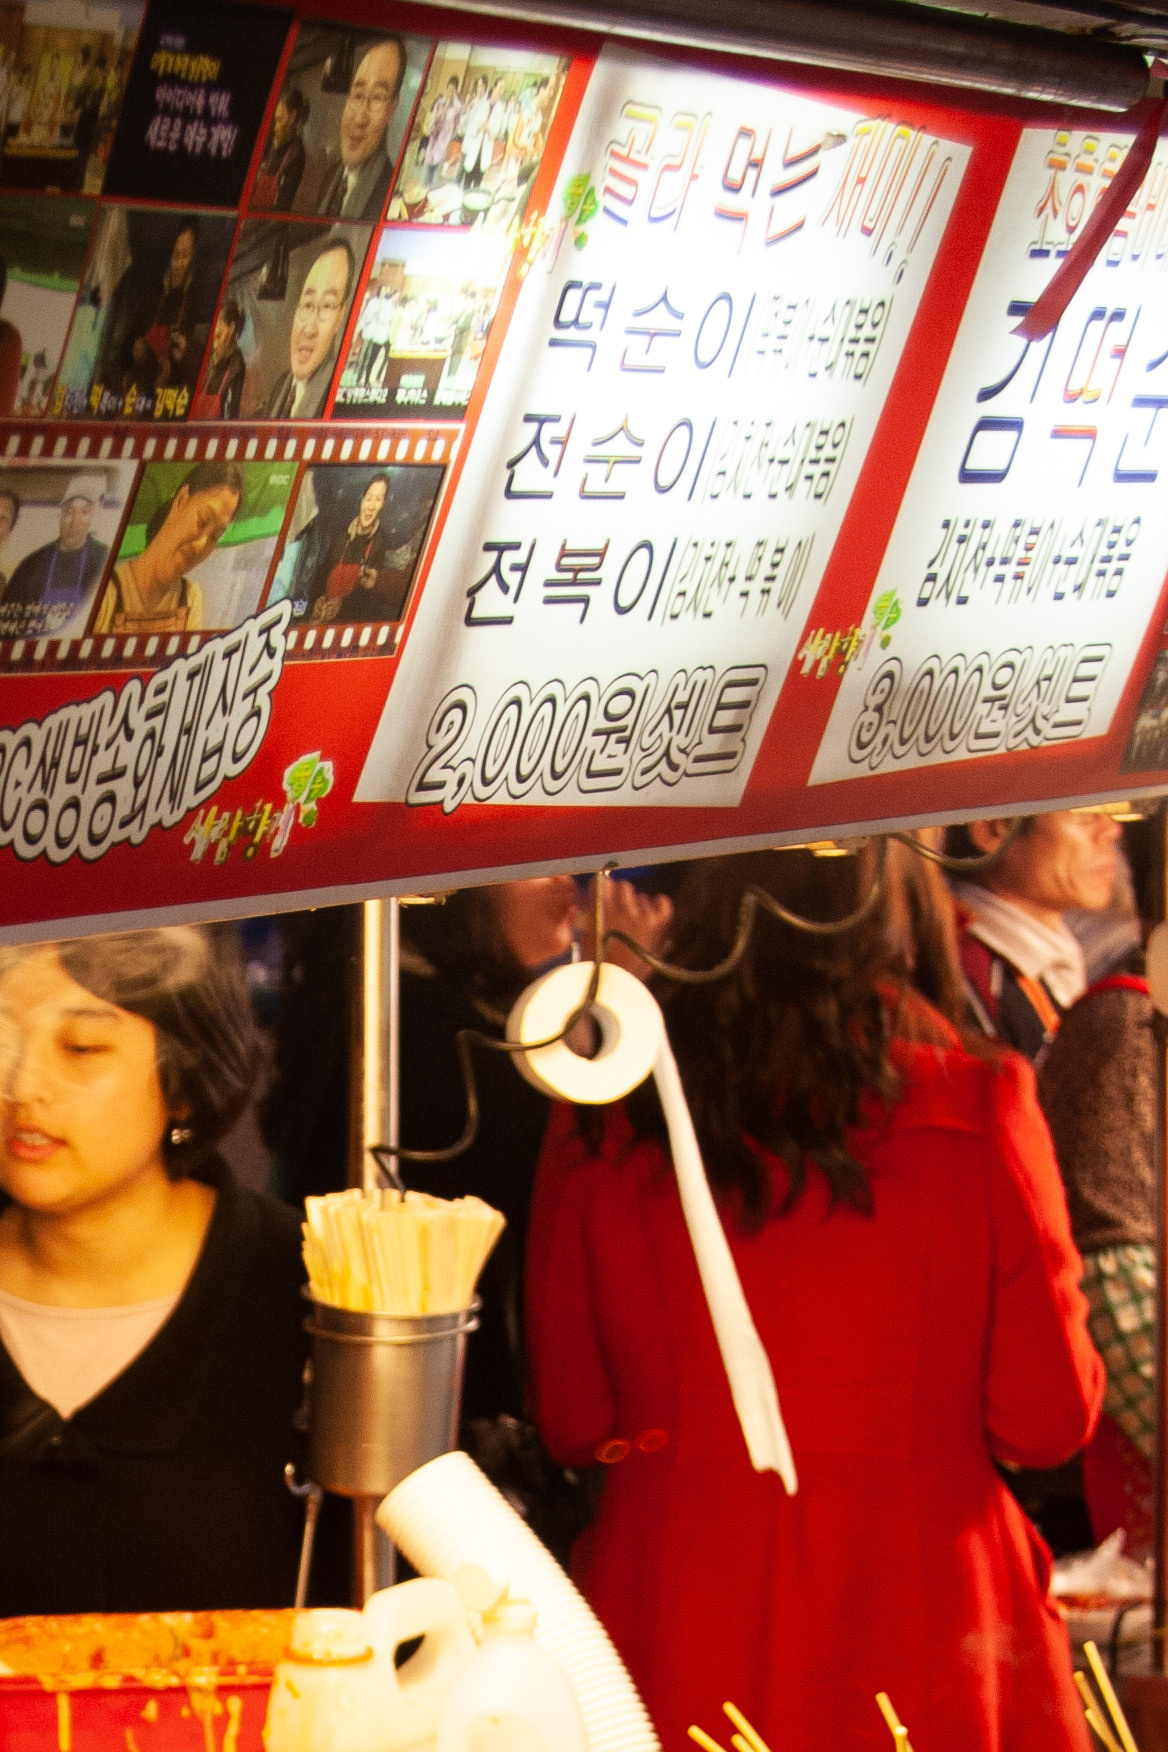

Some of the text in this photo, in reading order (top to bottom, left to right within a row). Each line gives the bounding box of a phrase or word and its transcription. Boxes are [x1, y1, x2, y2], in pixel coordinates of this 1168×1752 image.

[602, 99, 713, 234] 골라
[714, 124, 822, 255] 먹는
[820, 112, 954, 286] 재미!!
[549, 279, 757, 377] 떡순이
[503, 413, 717, 502] 전순이
[463, 536, 679, 629] 전복이
[407, 664, 770, 815] 2,000원셋트
[848, 643, 1114, 770] 3,000원셋트
